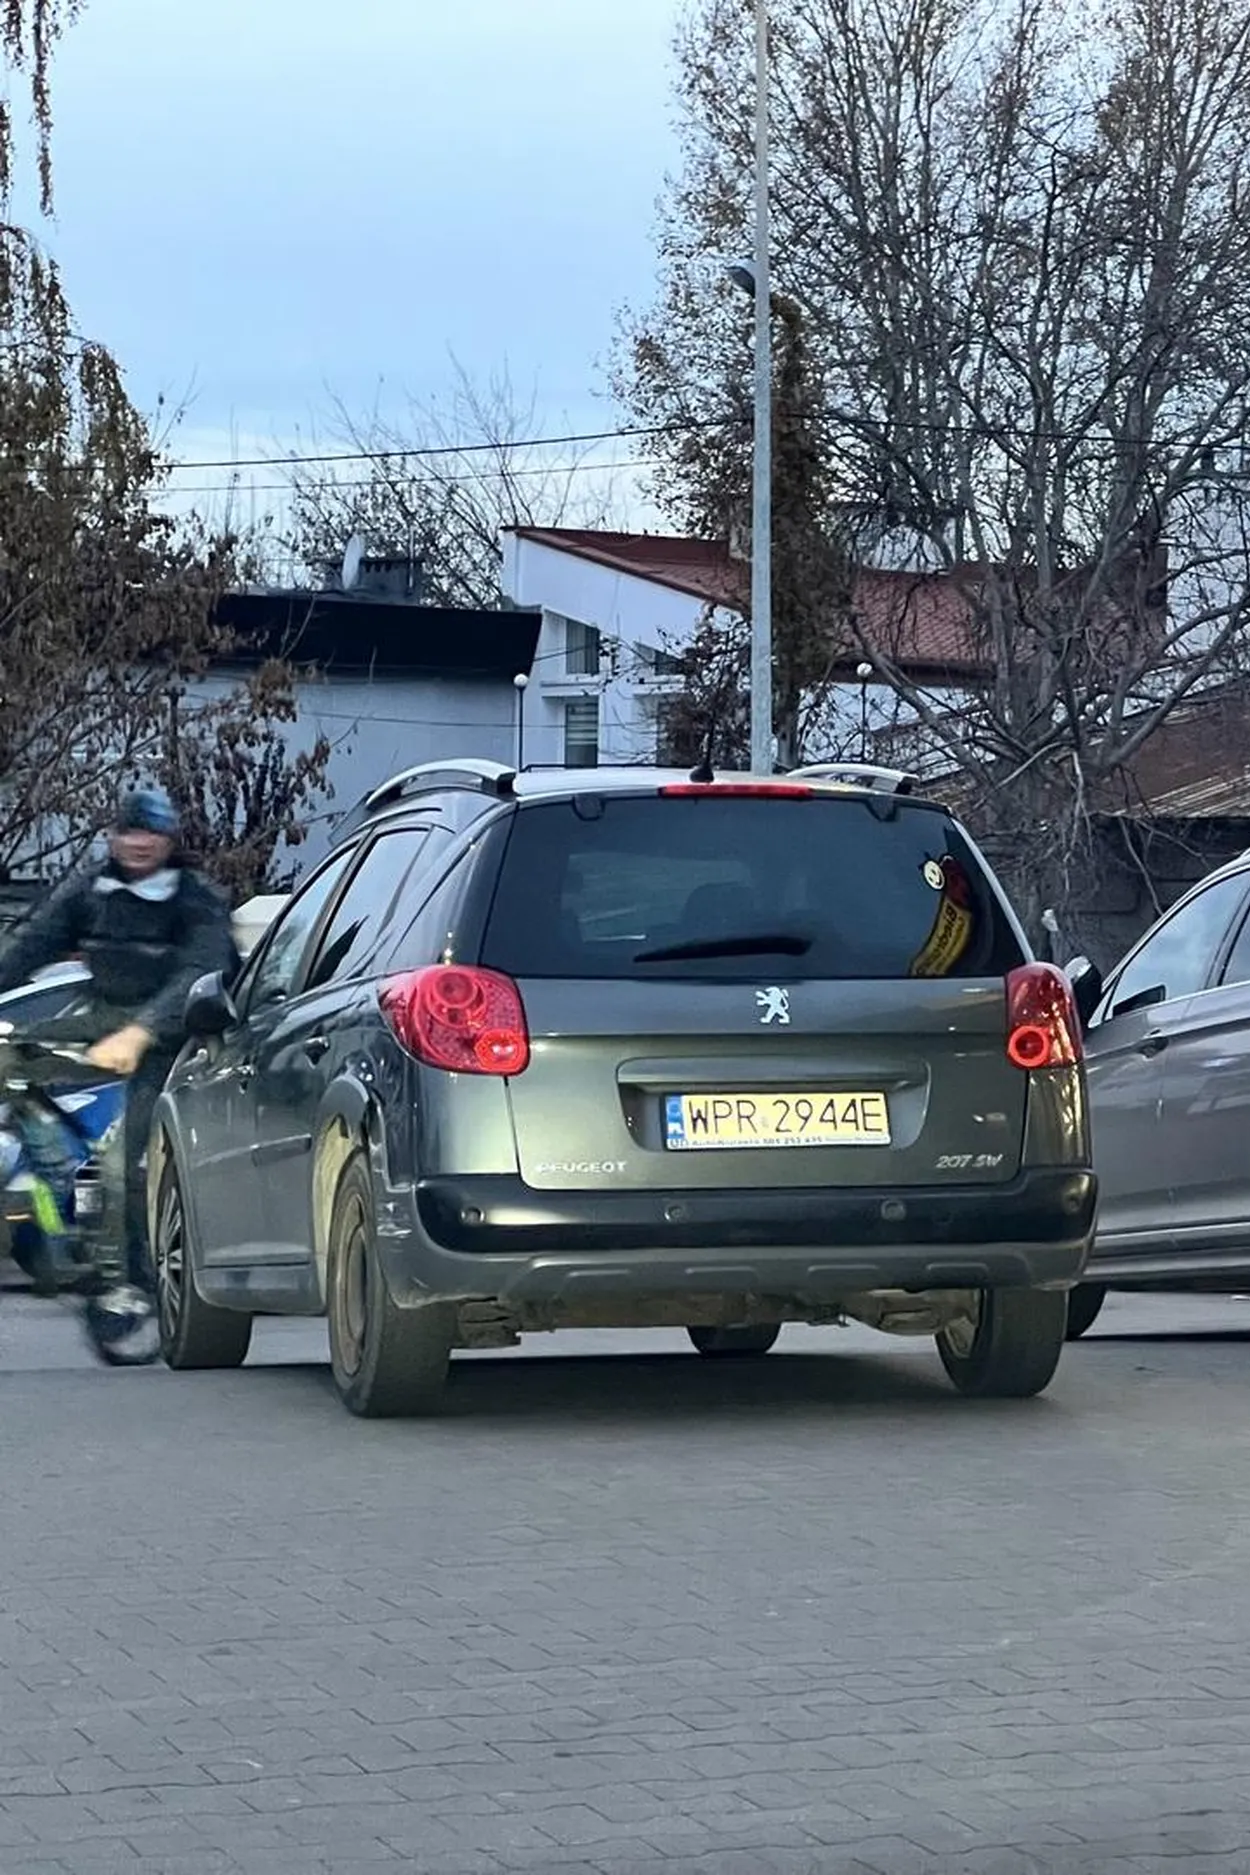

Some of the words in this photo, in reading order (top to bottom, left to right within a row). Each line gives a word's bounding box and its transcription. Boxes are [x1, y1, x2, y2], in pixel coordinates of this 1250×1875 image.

[688, 1099, 758, 1134] WPR
[772, 1098, 882, 1133] 2944E
[536, 1161, 628, 1174] PEUGEOT
[936, 1154, 973, 1169] 207
[972, 1153, 1003, 1168] SW
